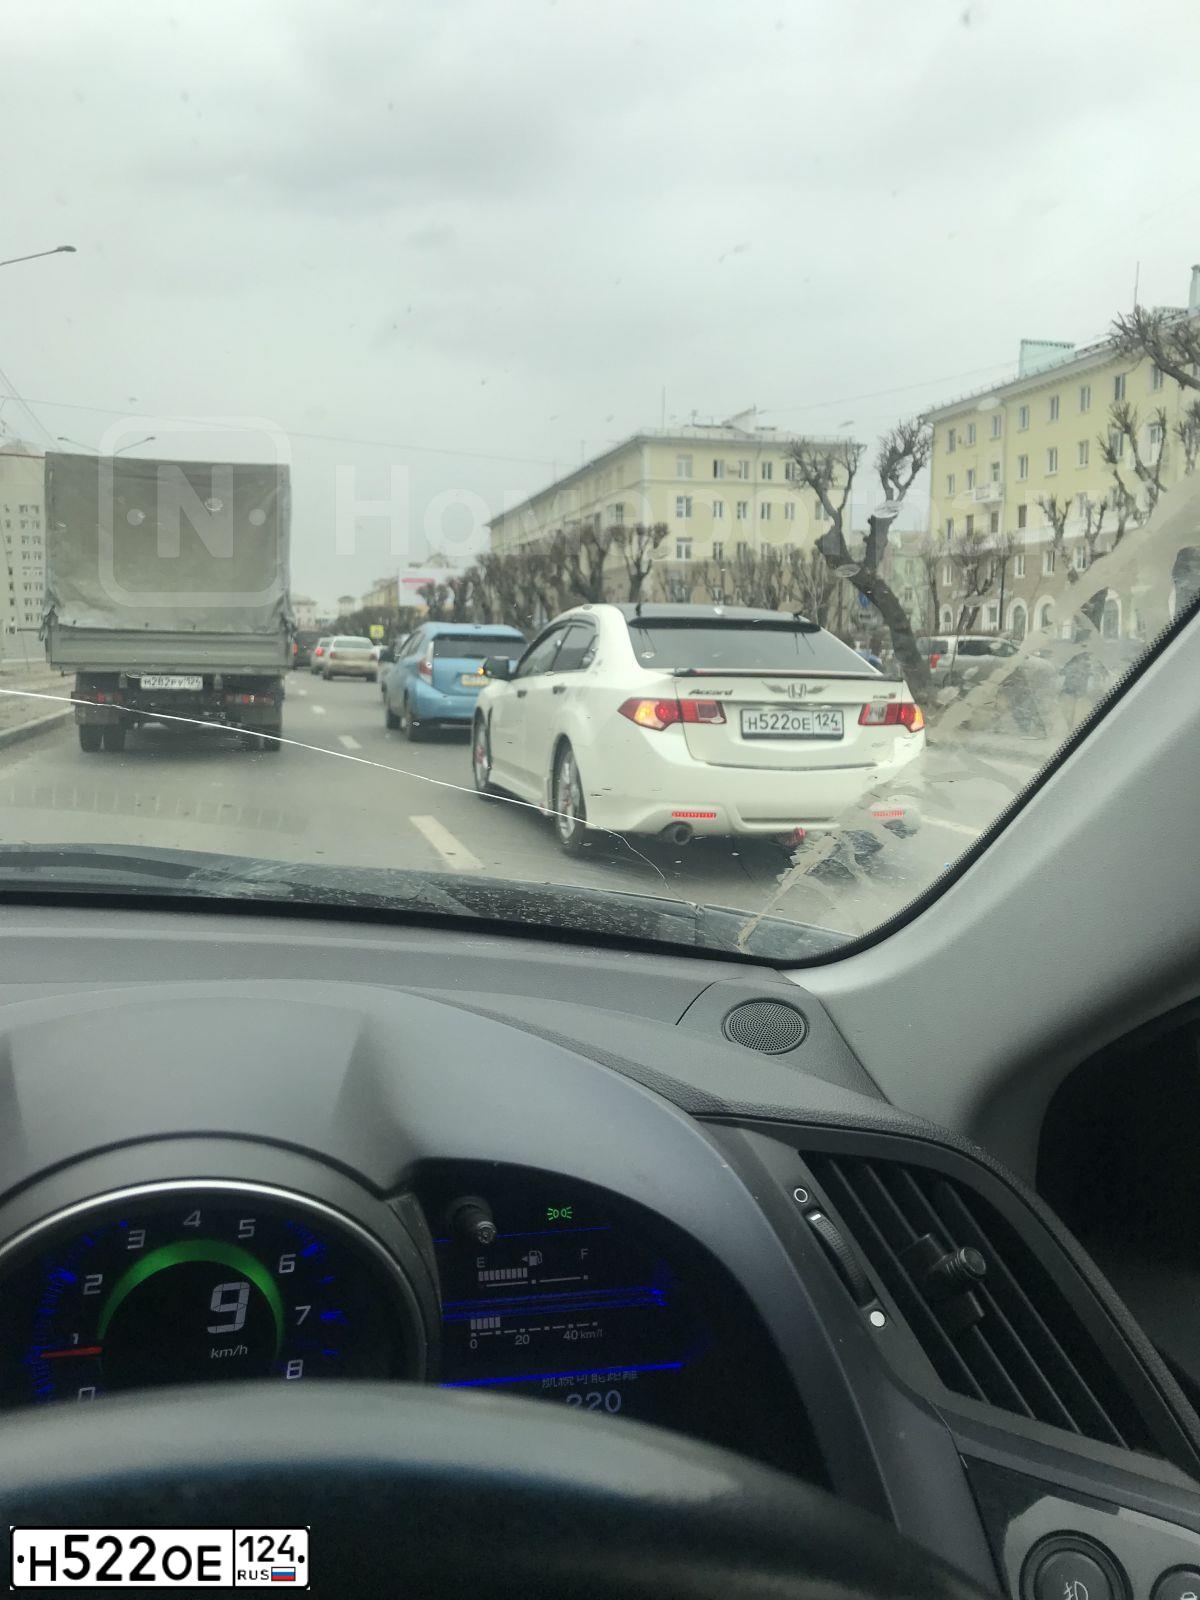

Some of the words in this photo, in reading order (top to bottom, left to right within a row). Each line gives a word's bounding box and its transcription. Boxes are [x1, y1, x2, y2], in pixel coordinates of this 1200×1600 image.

[747, 713, 812, 731] Н522ОЕ
[815, 713, 838, 727] 124
[183, 1210, 201, 1228] 4
[238, 1219, 256, 1239] 5
[126, 1229, 146, 1250] 3
[278, 1254, 296, 1273] 6
[476, 1256, 485, 1268] E
[580, 1249, 589, 1260] F
[83, 1273, 103, 1295] 2
[207, 1282, 250, 1334] 9
[294, 1305, 312, 1325] 7
[72, 1333, 79, 1344] 1
[470, 1338, 478, 1350] 0
[515, 1334, 530, 1346] 20
[563, 1329, 579, 1341] 40
[210, 1343, 248, 1359] km/h
[286, 1359, 304, 1379] 8
